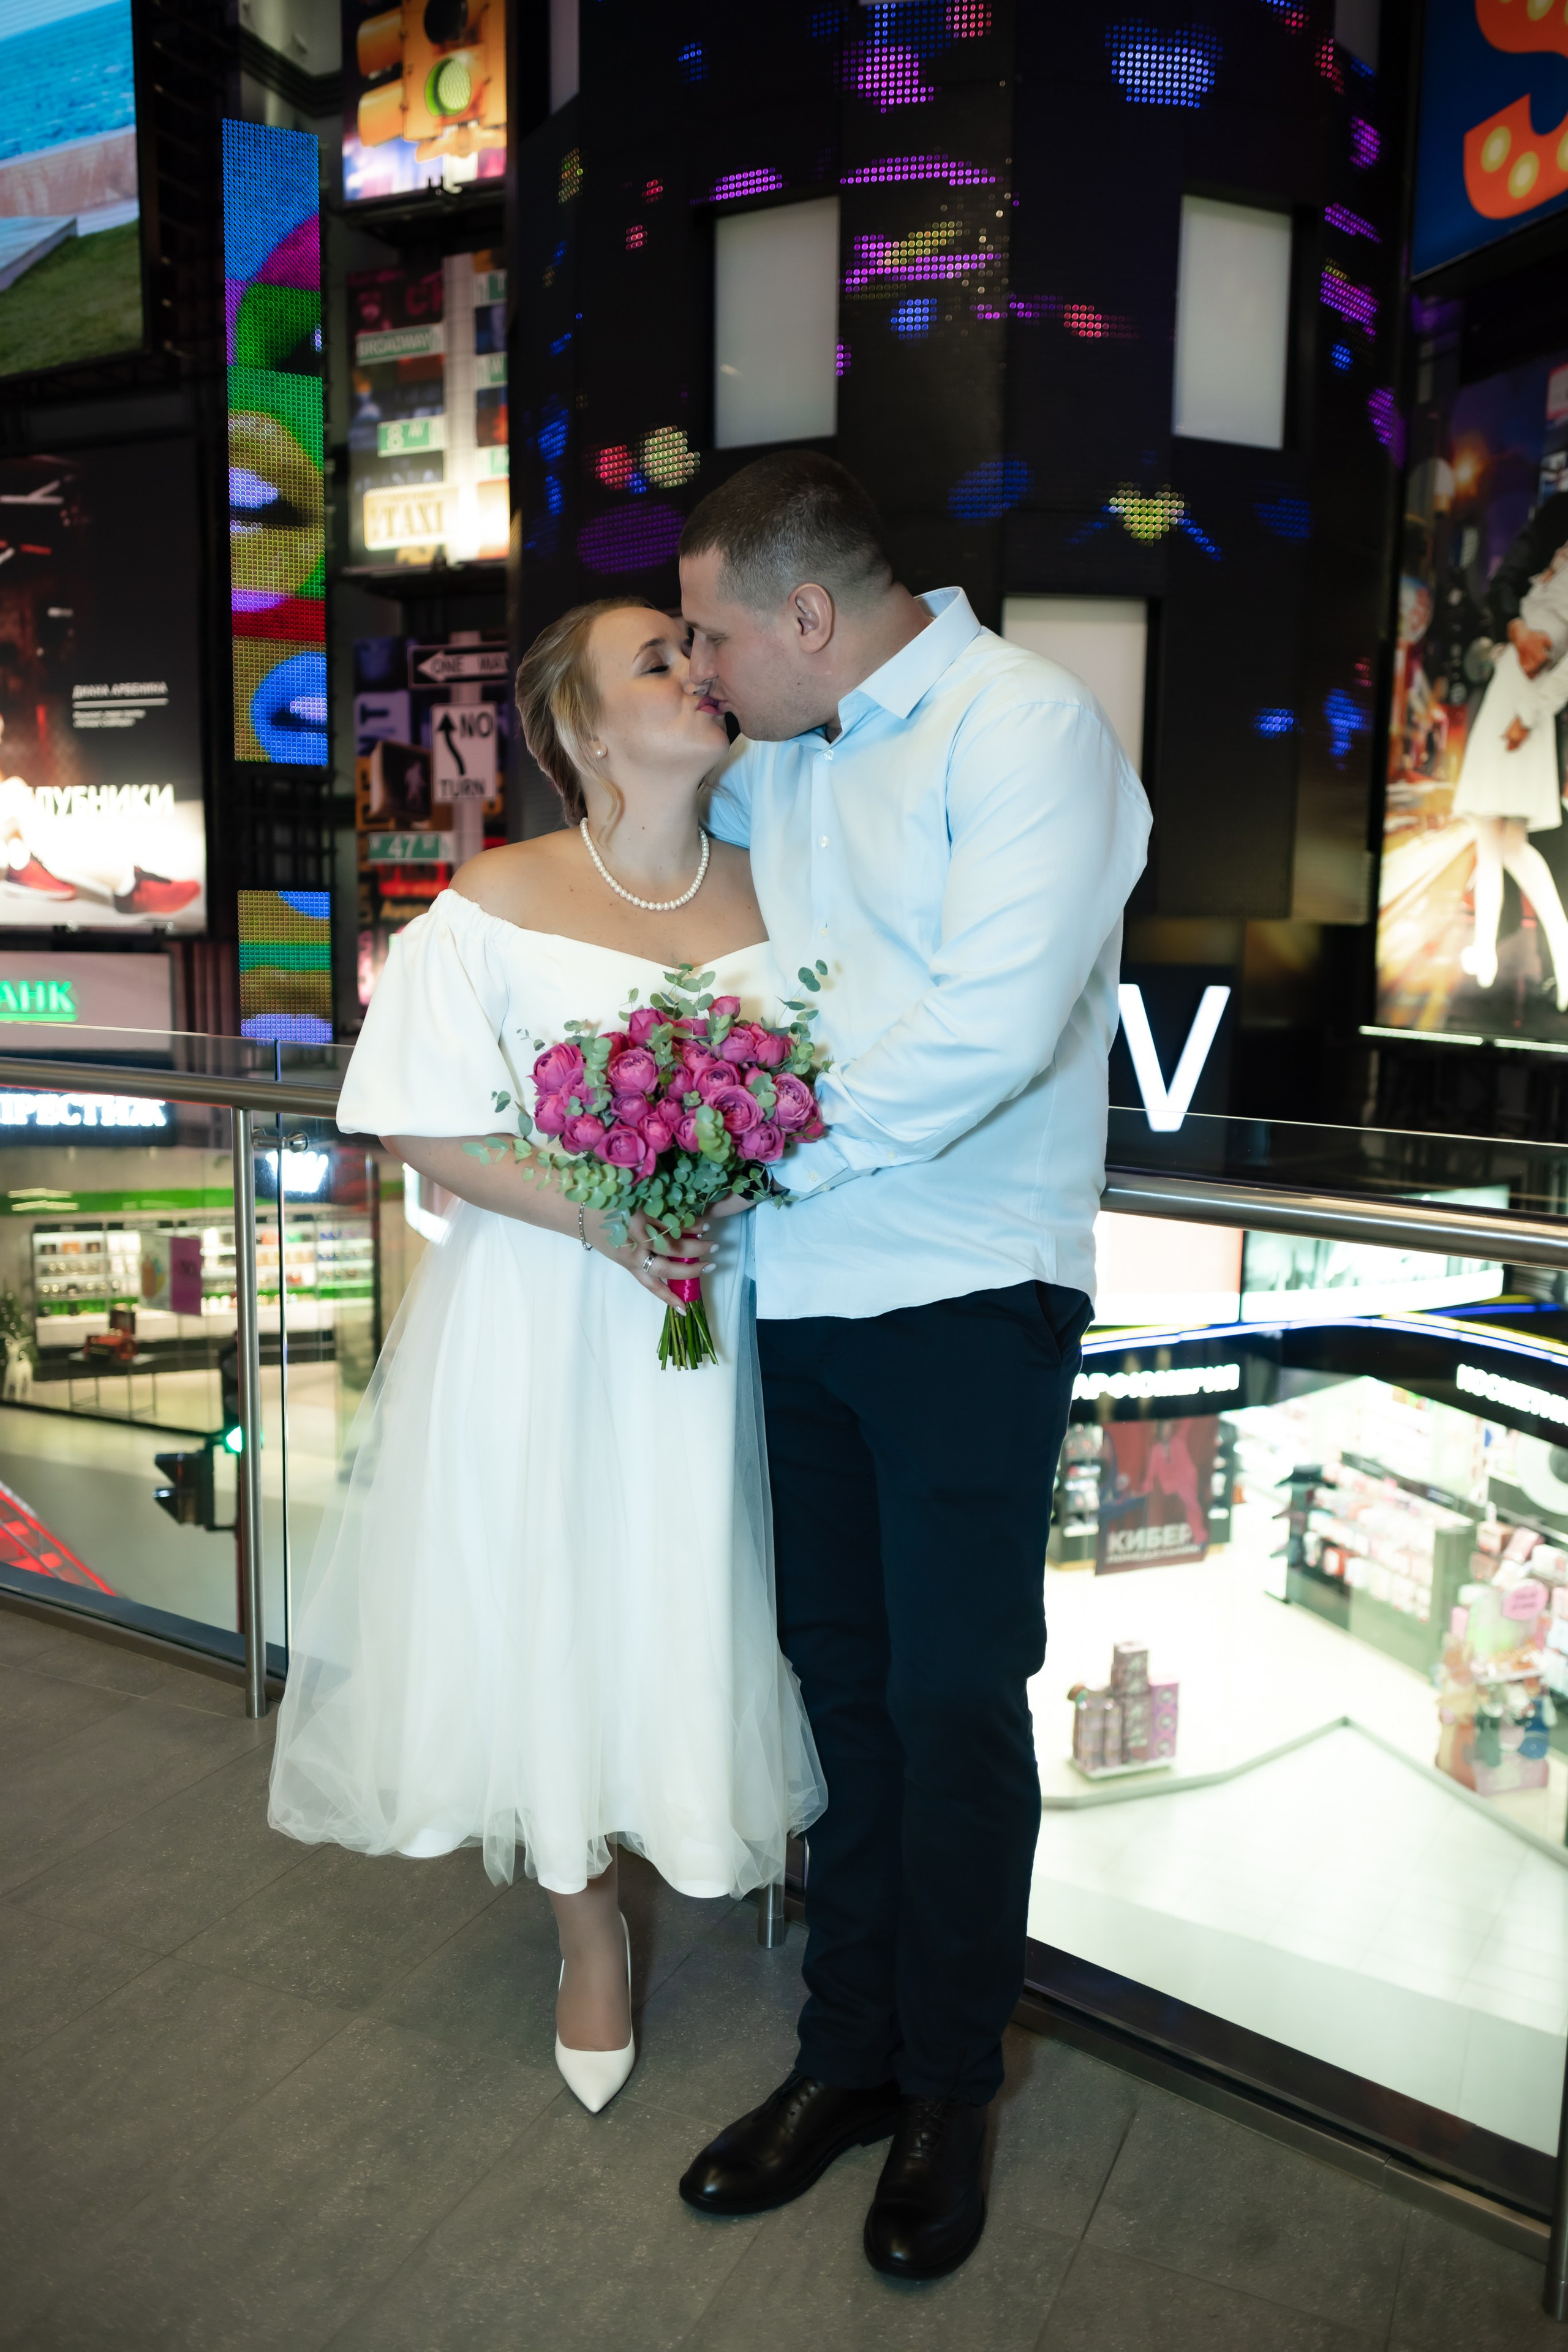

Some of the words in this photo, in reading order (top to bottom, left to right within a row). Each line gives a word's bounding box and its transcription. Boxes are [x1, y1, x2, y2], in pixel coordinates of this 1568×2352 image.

[360, 333, 429, 358] BROADWAY
[386, 424, 404, 450] 8
[382, 500, 443, 538] TAXI
[429, 656, 463, 674] ONE
[460, 712, 493, 739] NO
[26, 783, 175, 818] ЛУБНИКИ
[440, 778, 486, 798] TURN
[387, 834, 418, 859] 47
[1107, 1523, 1193, 1555] КИБЕР
